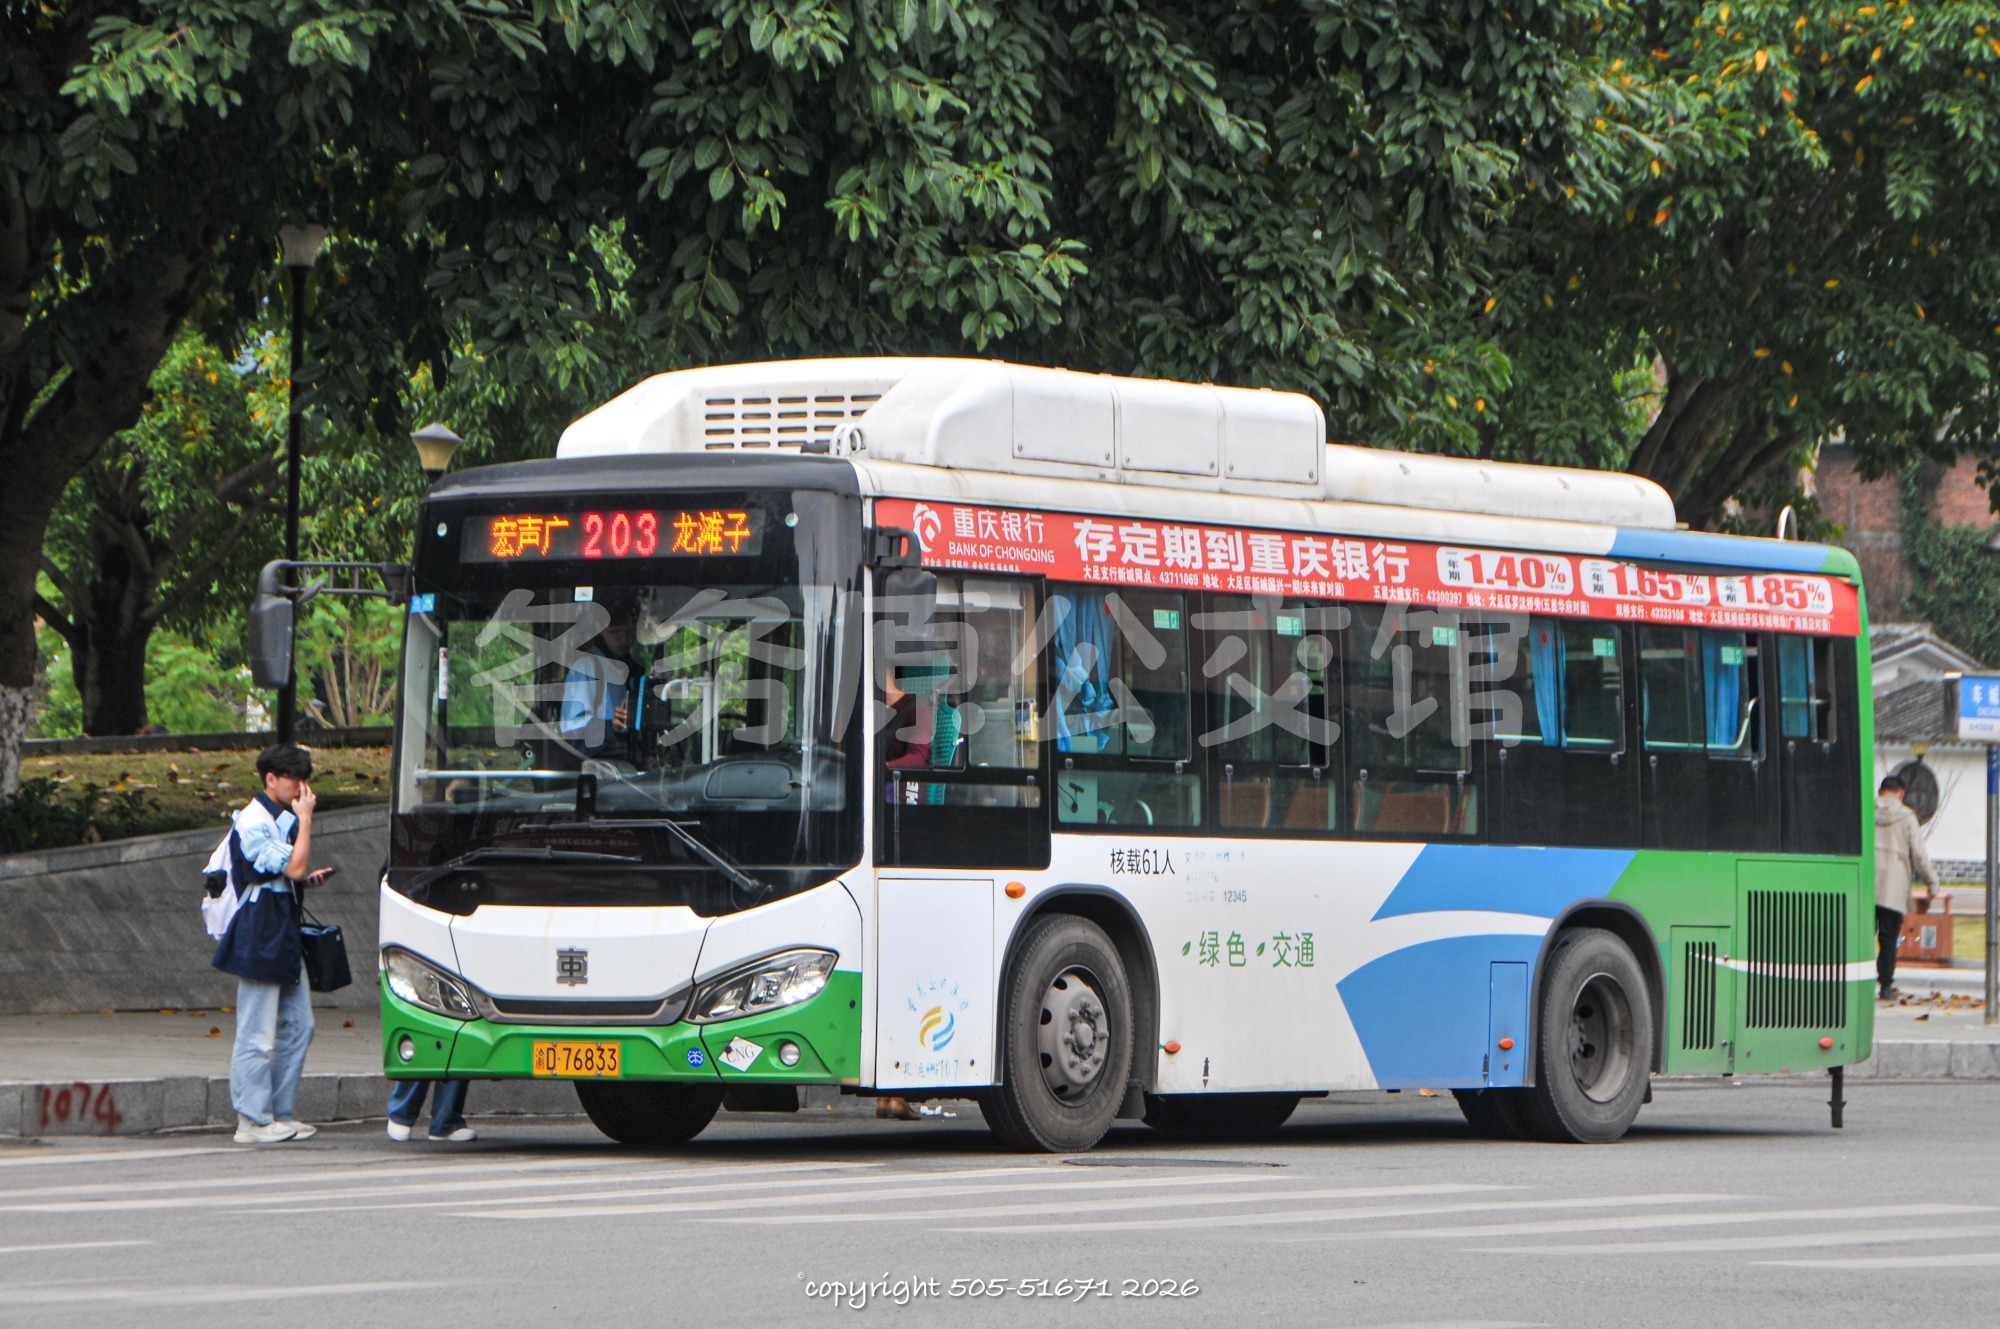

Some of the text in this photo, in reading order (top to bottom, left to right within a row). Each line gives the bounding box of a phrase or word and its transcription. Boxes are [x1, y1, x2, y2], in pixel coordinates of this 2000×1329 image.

[491, 511, 751, 559] 宏声广 203 龙滩子
[952, 506, 1045, 544] 重庆银行
[948, 541, 1055, 564] BANK OF CHONGQING
[1073, 518, 1409, 584] 存定期到重庆银行
[1464, 553, 1567, 589] 1.40%
[1608, 564, 1705, 601] 1.65%
[1739, 575, 1826, 610] 1.85%
[1110, 848, 1176, 875] 核载61人
[1223, 890, 1247, 903] 12345
[1199, 930, 1315, 968] 绿色 交通
[726, 1044, 755, 1064] CNG
[39, 1080, 123, 1135] 1074
